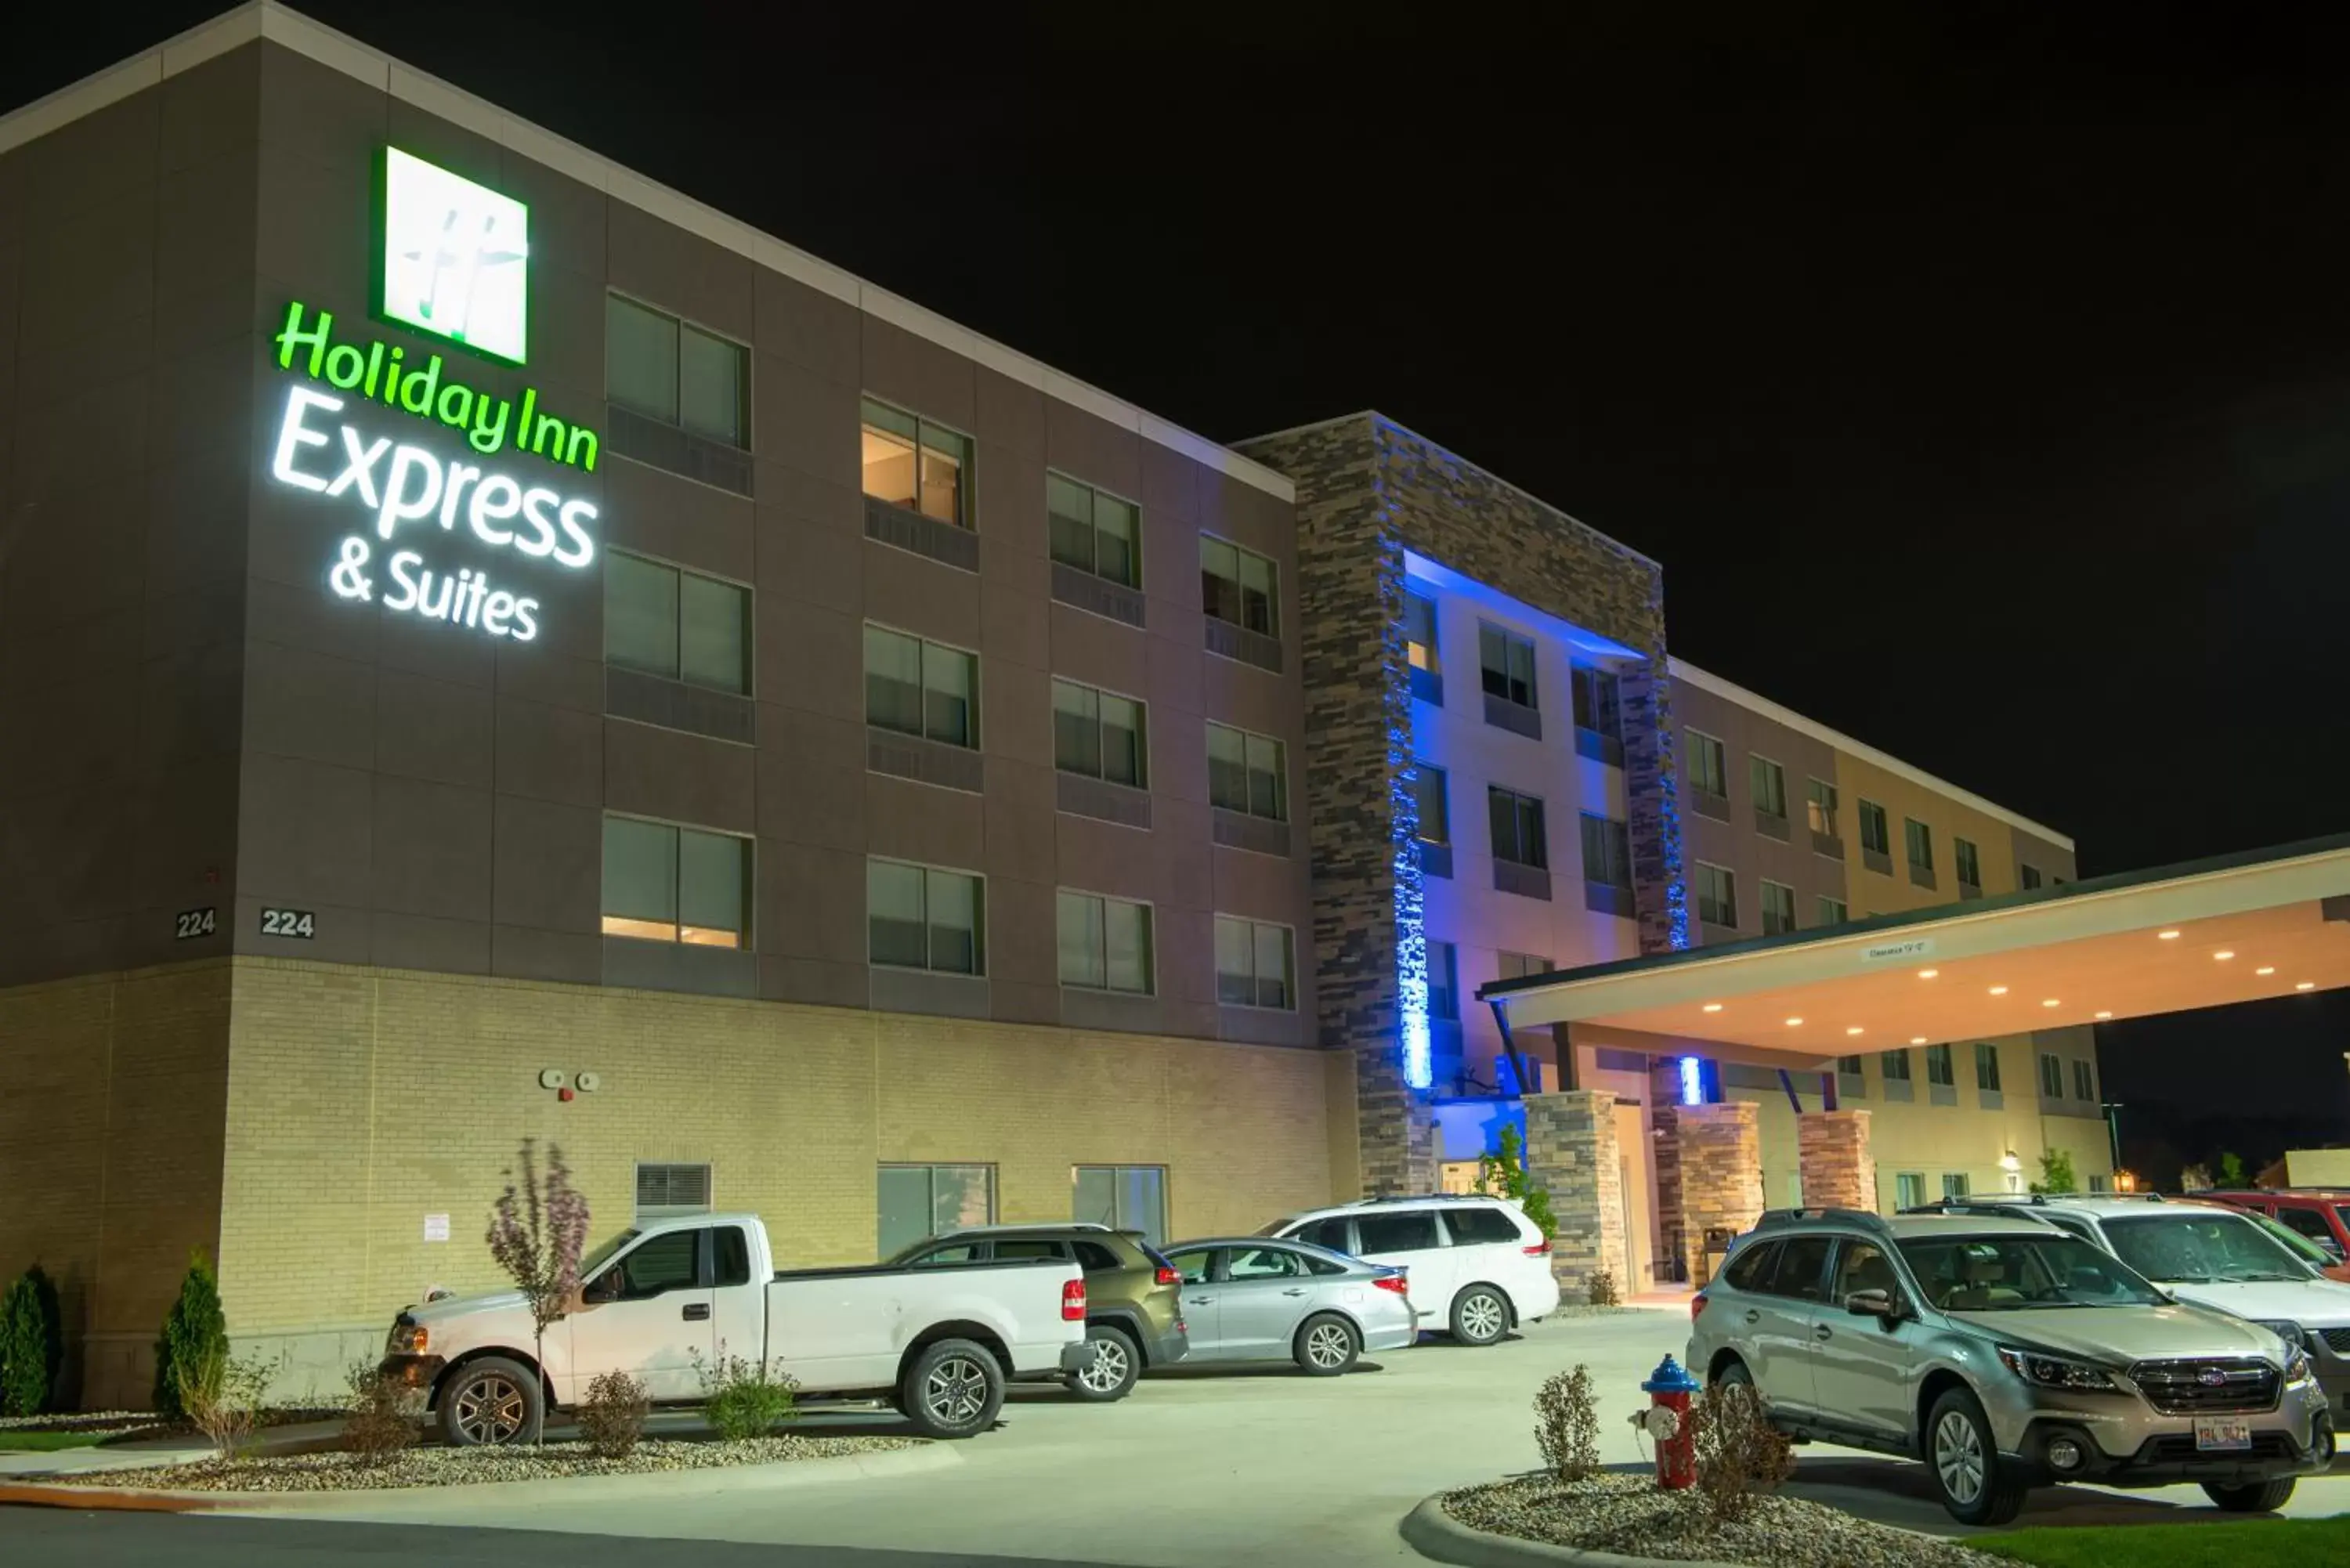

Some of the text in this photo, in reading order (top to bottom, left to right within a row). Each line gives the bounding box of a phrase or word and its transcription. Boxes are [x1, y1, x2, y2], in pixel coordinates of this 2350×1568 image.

[276, 302, 598, 472] Holiday Inn
[273, 385, 598, 568] Express
[330, 536, 540, 641] & Suites
[178, 909, 215, 938] 224
[262, 910, 313, 938] 224
